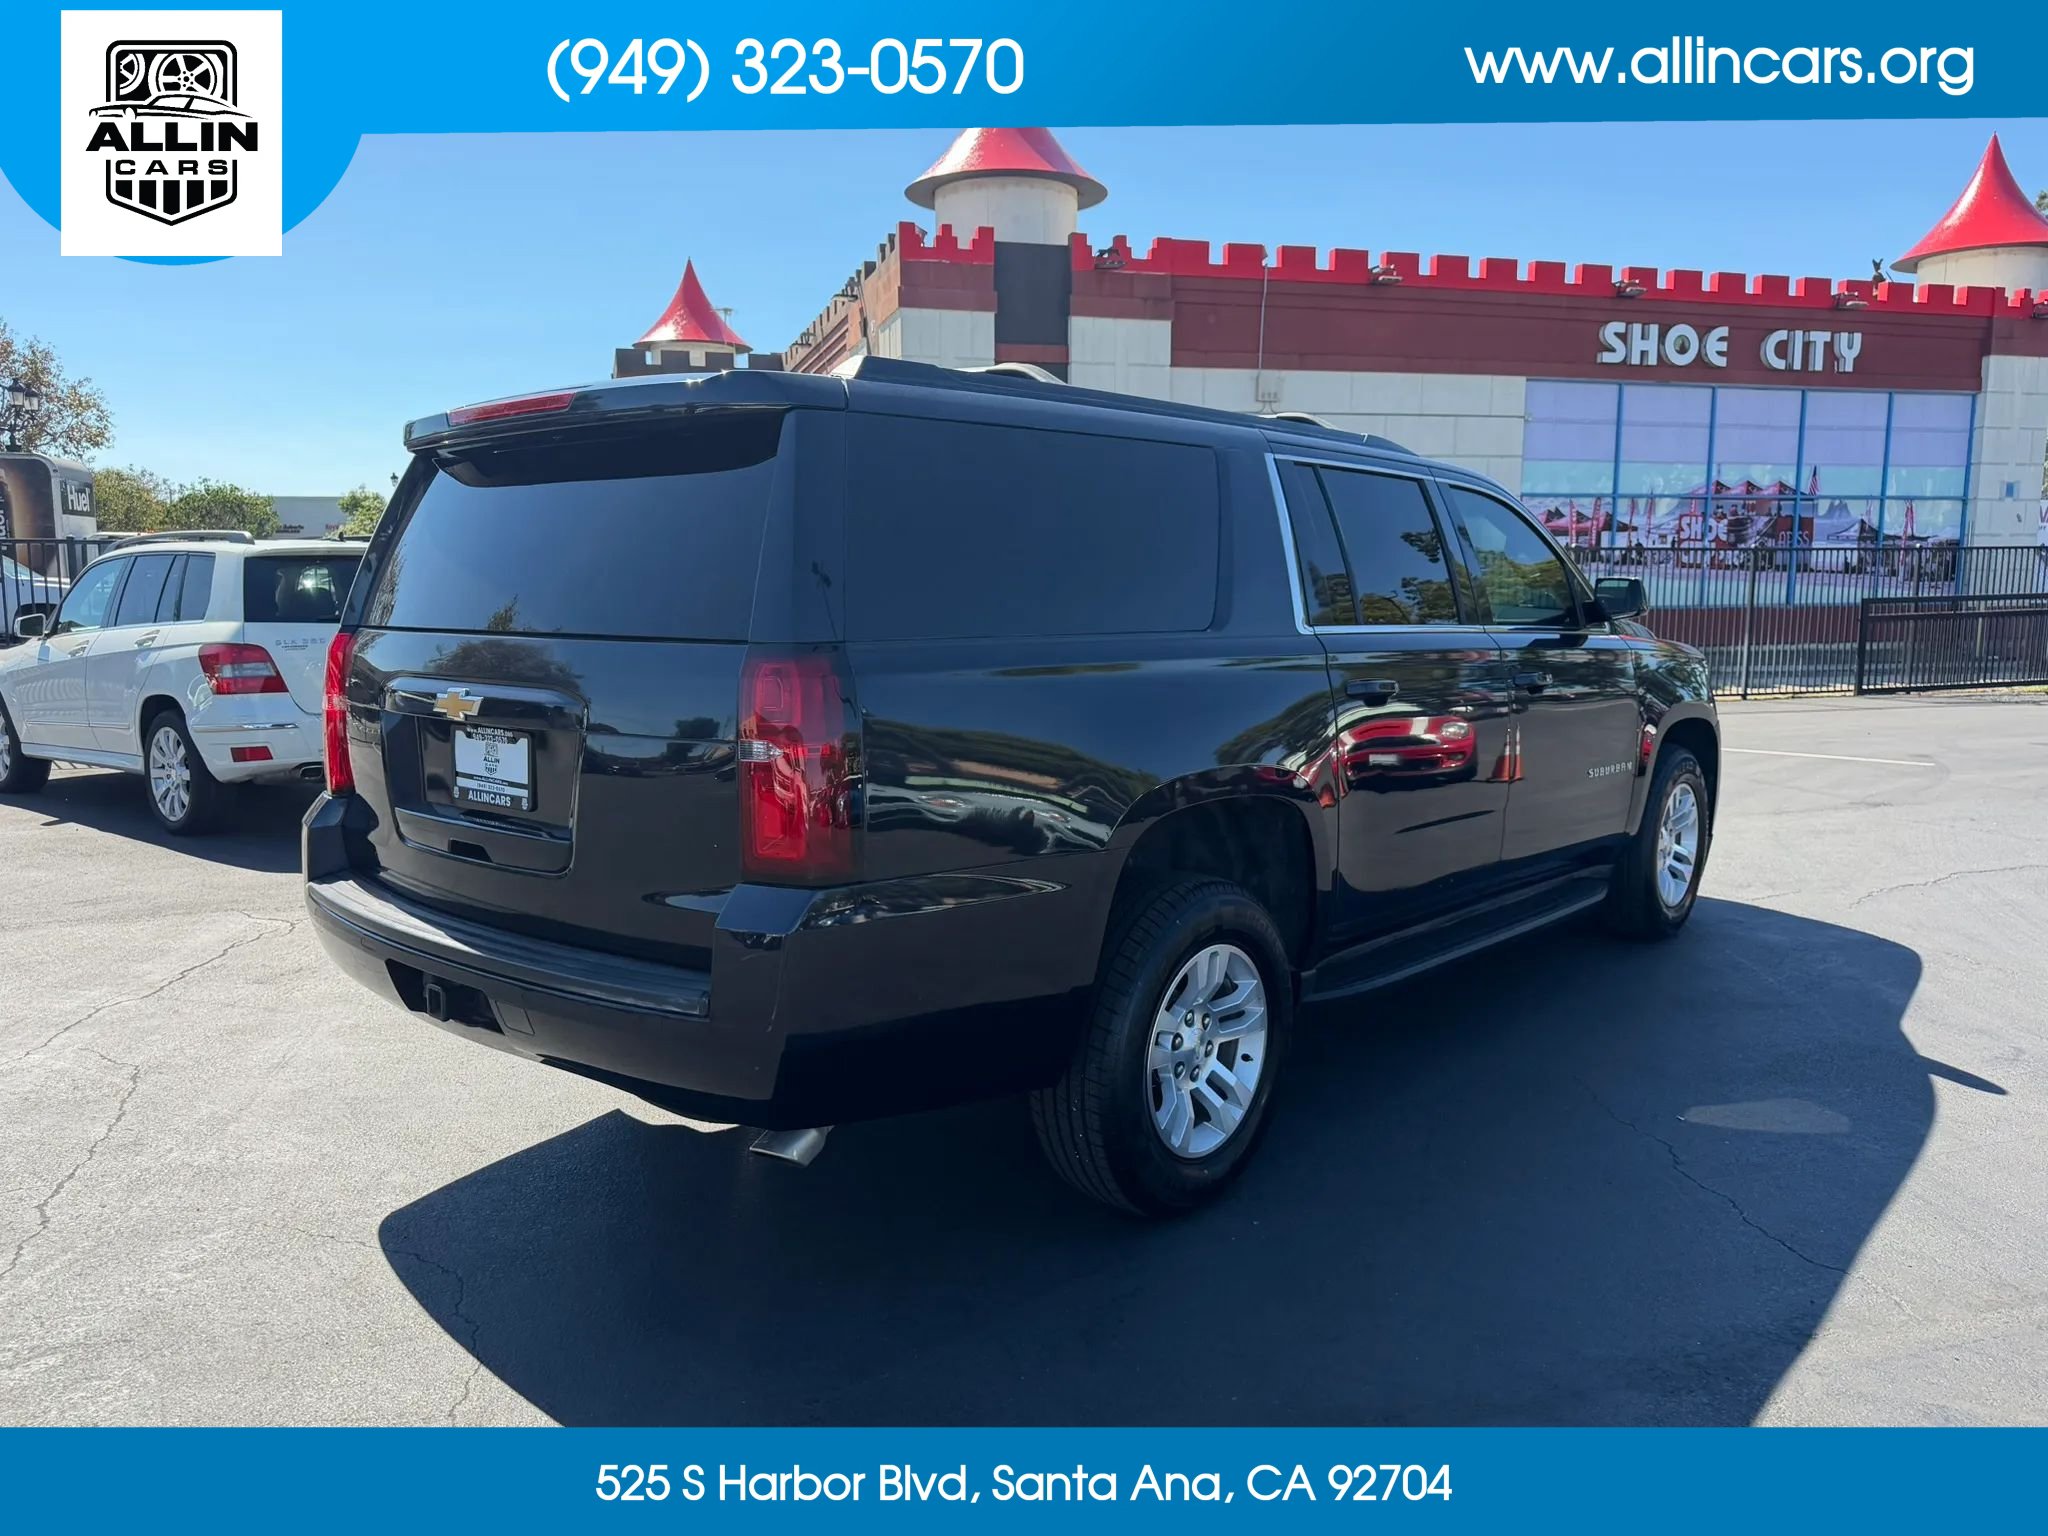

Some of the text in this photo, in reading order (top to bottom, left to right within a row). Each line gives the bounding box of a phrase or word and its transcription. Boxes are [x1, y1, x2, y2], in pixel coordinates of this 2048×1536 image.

[1597, 321, 1862, 373] SHOE CITY
[67, 484, 91, 512] Huel
[483, 756, 500, 764] ALLIN
[1588, 761, 1633, 778] SUBURBAN
[467, 790, 511, 807] ALLINCARS
